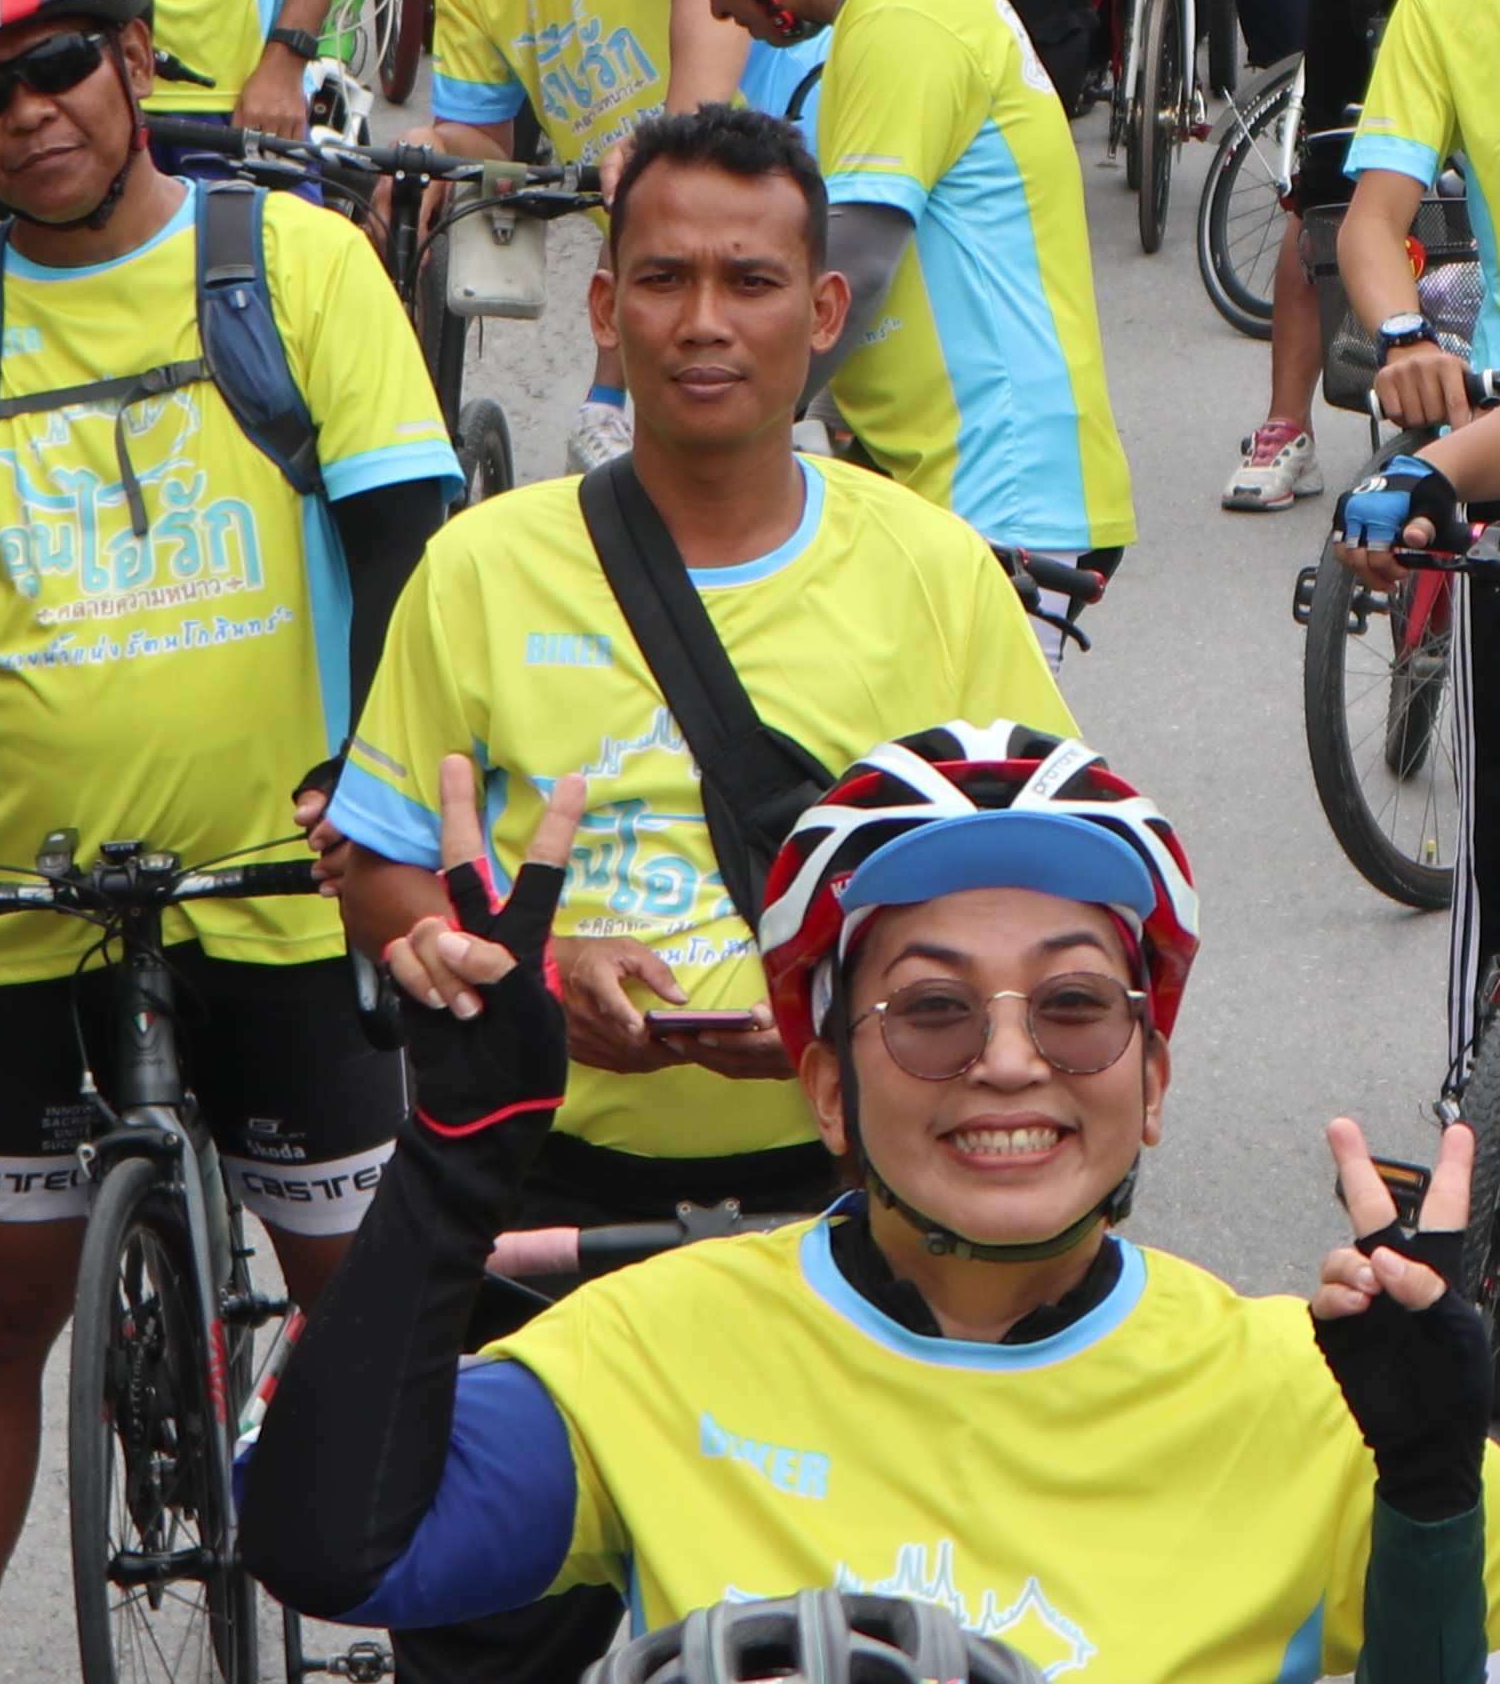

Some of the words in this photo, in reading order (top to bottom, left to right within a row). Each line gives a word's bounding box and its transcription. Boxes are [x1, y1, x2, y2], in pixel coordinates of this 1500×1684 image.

[57, 580, 223, 625] คลายความหนาว
[525, 633, 615, 667] BIKER
